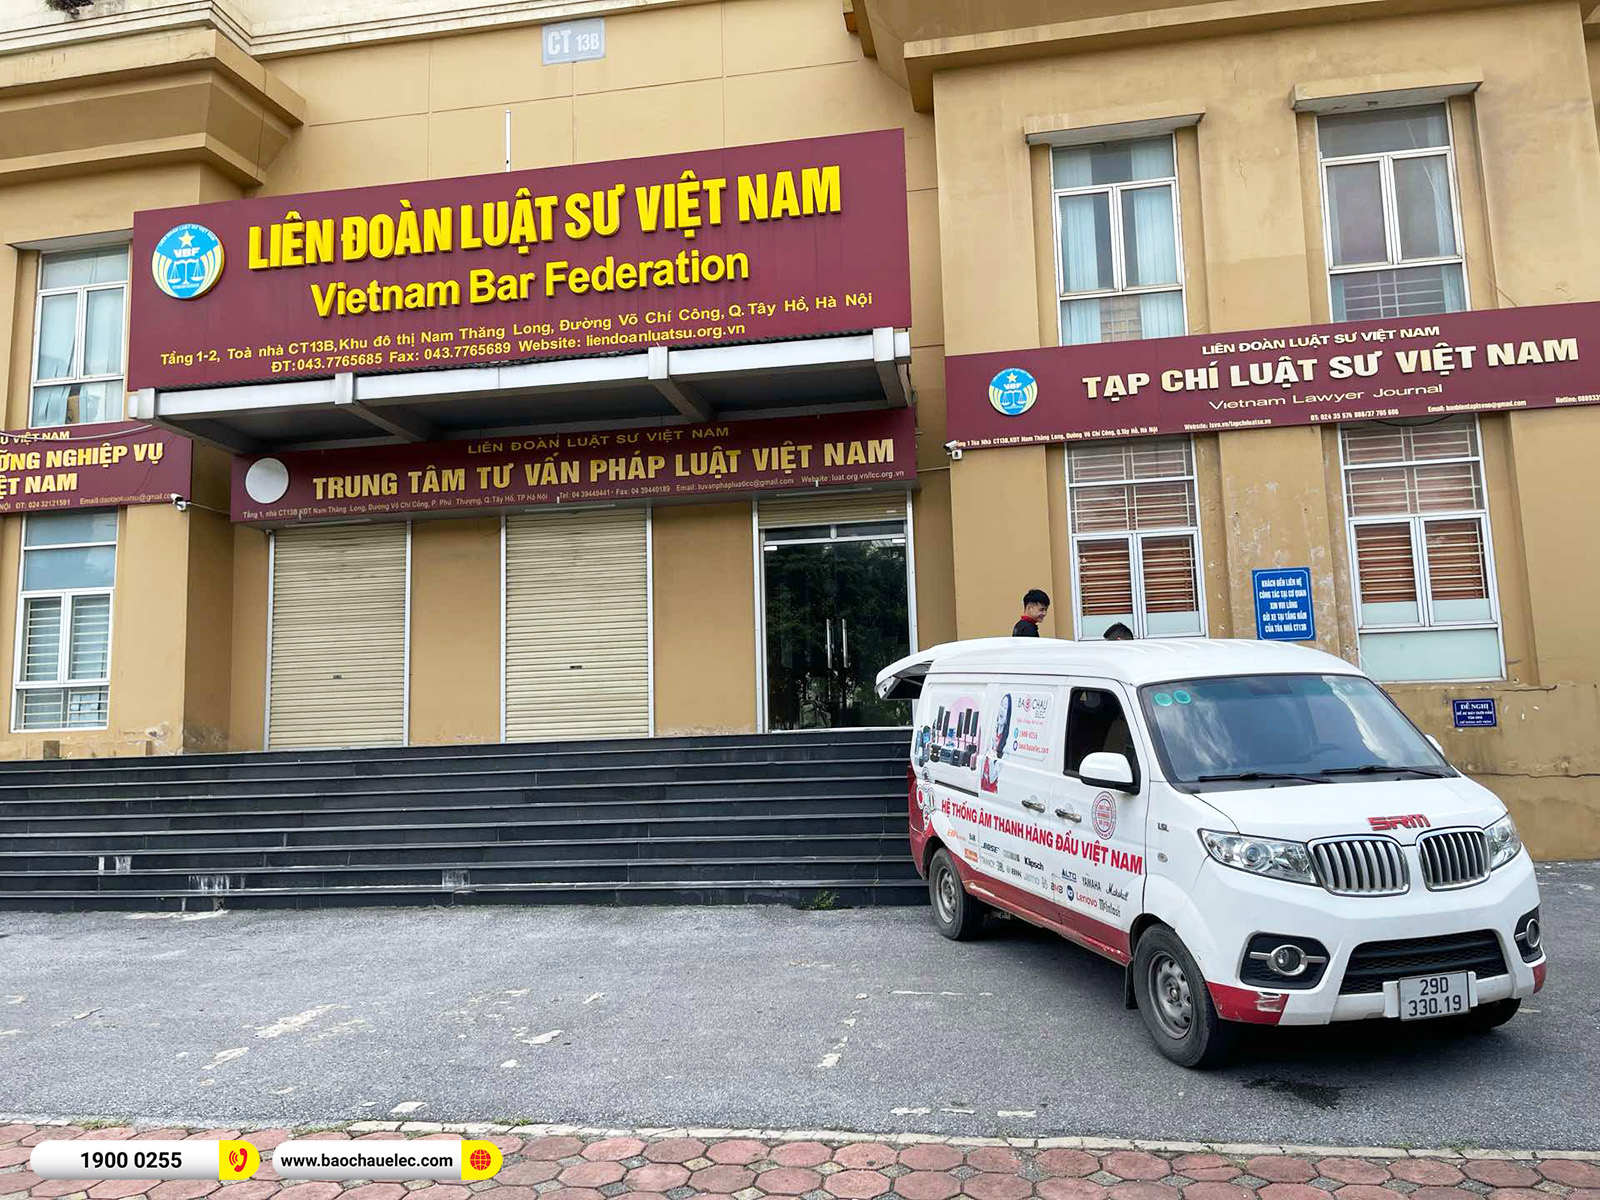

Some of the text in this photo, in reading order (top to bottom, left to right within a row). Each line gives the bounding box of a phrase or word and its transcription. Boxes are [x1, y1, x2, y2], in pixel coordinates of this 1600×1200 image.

[548, 29, 600, 55] CT 13B
[249, 165, 841, 270] LIÊN ĐOÀN LUẬT SƯ VIỆT NAM
[310, 248, 750, 318] Vietnam Bar Federation
[160, 352, 193, 367] Tầng
[196, 350, 220, 363] 1-2,
[227, 346, 252, 360] Toà
[259, 344, 283, 358] nhà
[373, 334, 391, 347] đô
[397, 333, 414, 347] thị
[421, 330, 454, 343] Nam
[459, 326, 505, 340] Thăng
[513, 323, 555, 336] Long,
[559, 316, 611, 331] Đường
[618, 313, 638, 326] Võ
[645, 309, 672, 324] Chí
[679, 307, 725, 323] Công,
[784, 295, 809, 313] Hồ,
[815, 296, 837, 310] Hà
[845, 292, 873, 308] Nội
[1202, 326, 1440, 356] LIÊN ĐOÀN LUẬT SƯ VIỆT NAM
[389, 350, 419, 363] Fax:
[424, 341, 511, 360] 043.7765689
[519, 336, 581, 353] Website:
[586, 324, 745, 348] liendoanluatsu.org.vn
[1082, 337, 1580, 402] TẠP CHÍ LUẬT SƯ VIỆT NAM
[1209, 383, 1443, 411] Vietnam Lawyer Journal
[468, 427, 729, 454] LIÊN ĐOÀN LUẬT SƯ VIỆT NAM
[46, 442, 164, 469] NGHIỆP VỤ
[25, 472, 78, 494] NAM
[313, 439, 894, 500] TRUNG TÂM TƯ VẤN PHÁP LUẬT VIỆT NAM
[313, 506, 327, 514] Nam
[941, 797, 951, 818] HỆ
[952, 800, 978, 825] THỐNG
[979, 809, 992, 829] ÂM
[994, 816, 1025, 838] THANH
[1026, 823, 1054, 849] HÀNG
[1055, 829, 1079, 856] ĐẦU
[1081, 841, 1109, 869] VIỆT
[1110, 850, 1143, 876] NAM
[1024, 856, 1045, 871] Klipsch
[1076, 891, 1098, 908] Lenovo
[1420, 977, 1449, 997] 29D
[1408, 994, 1462, 1017] 330.19
